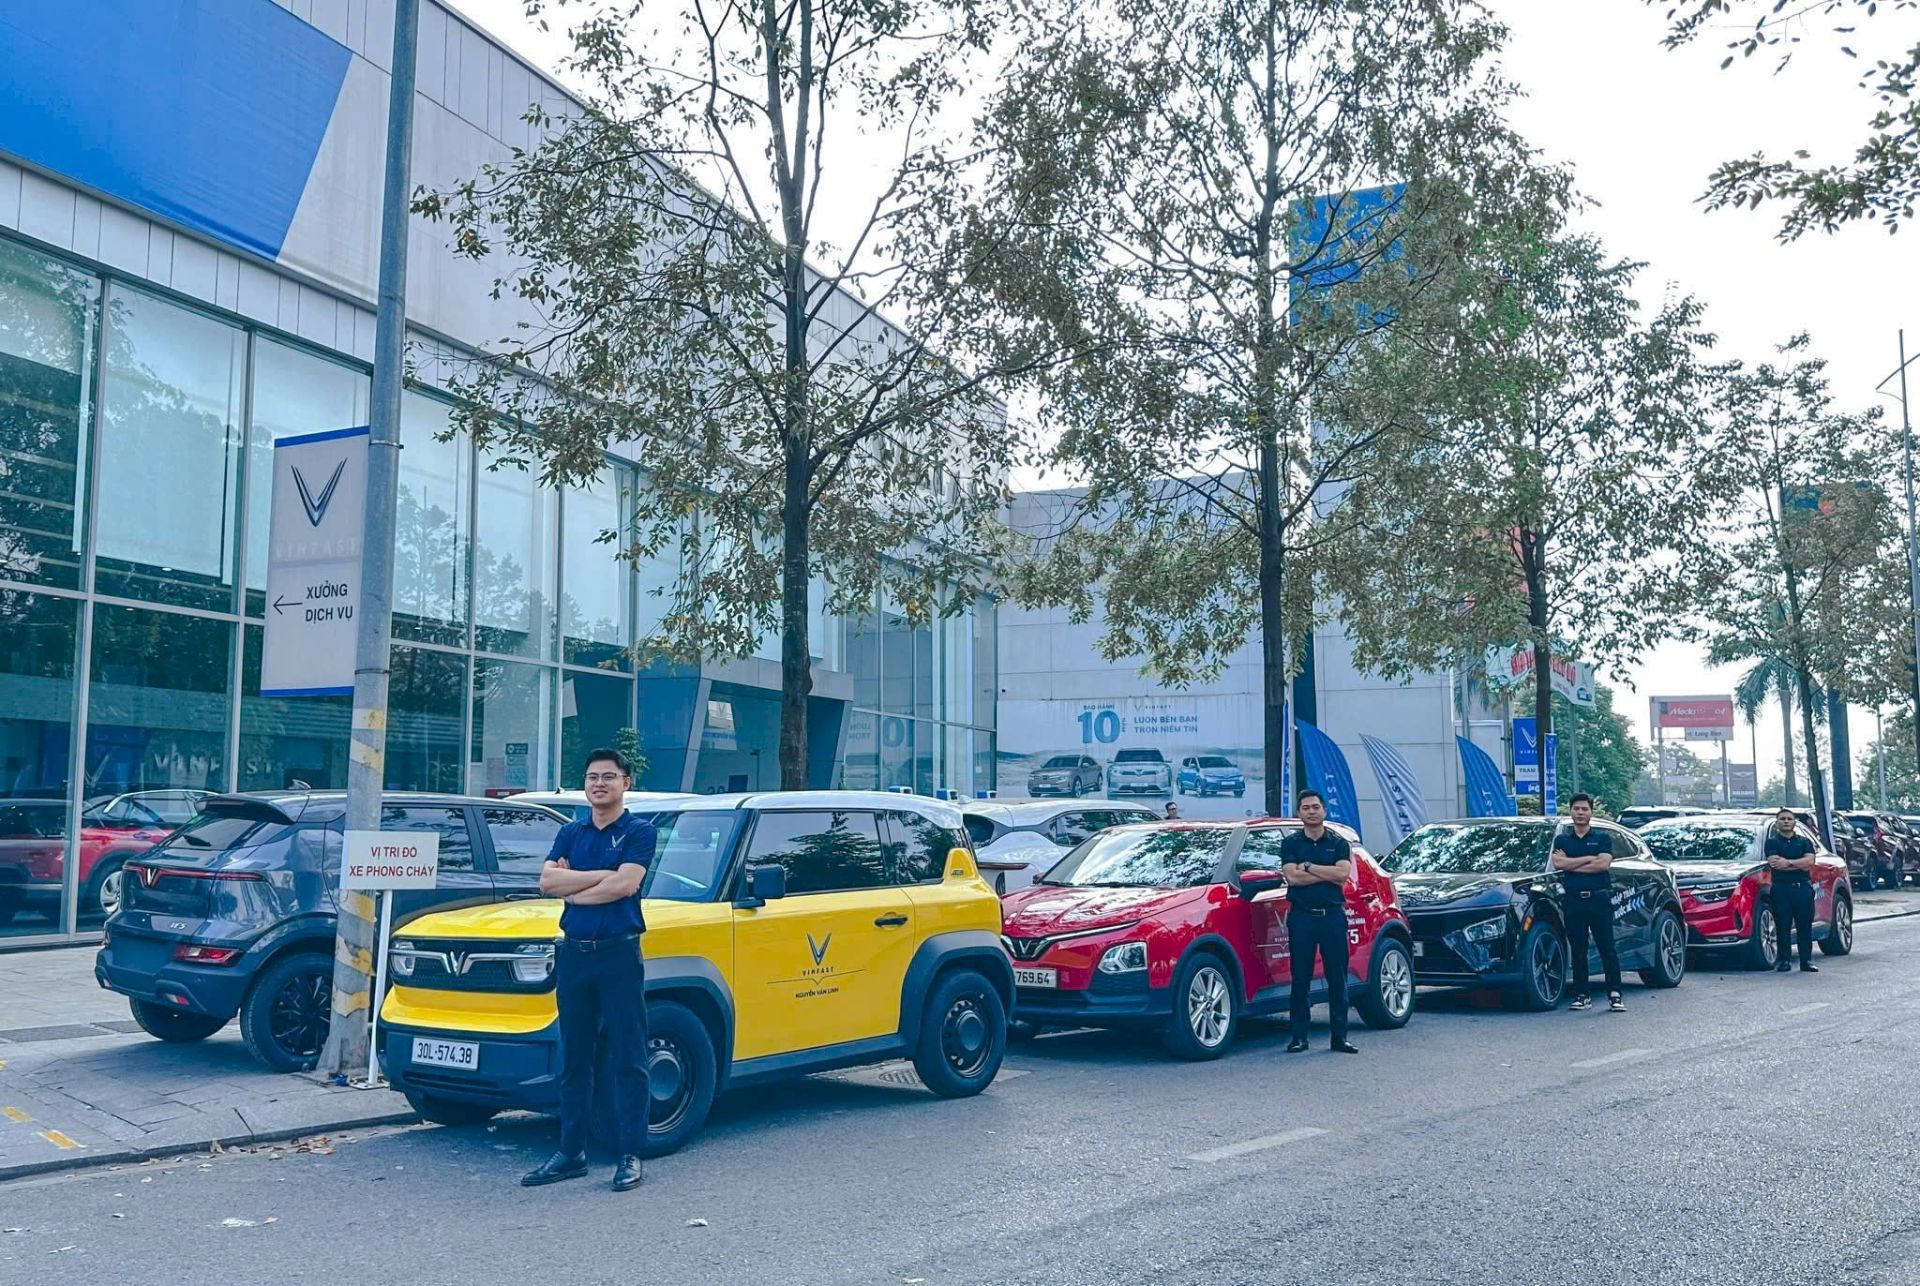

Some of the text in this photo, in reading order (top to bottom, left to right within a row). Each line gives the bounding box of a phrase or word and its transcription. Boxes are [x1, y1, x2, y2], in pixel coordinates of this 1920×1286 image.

[306, 580, 348, 599] XƯỞNG
[305, 606, 353, 624] DỊCH VỤ
[1078, 710, 1120, 744] 10
[1325, 772, 1341, 819] FAST
[1388, 773, 1412, 833] NFAST
[371, 846, 380, 860] VỊ
[349, 865, 363, 877] XE
[802, 966, 835, 977] VINFAST
[1016, 971, 1050, 985] 769.64
